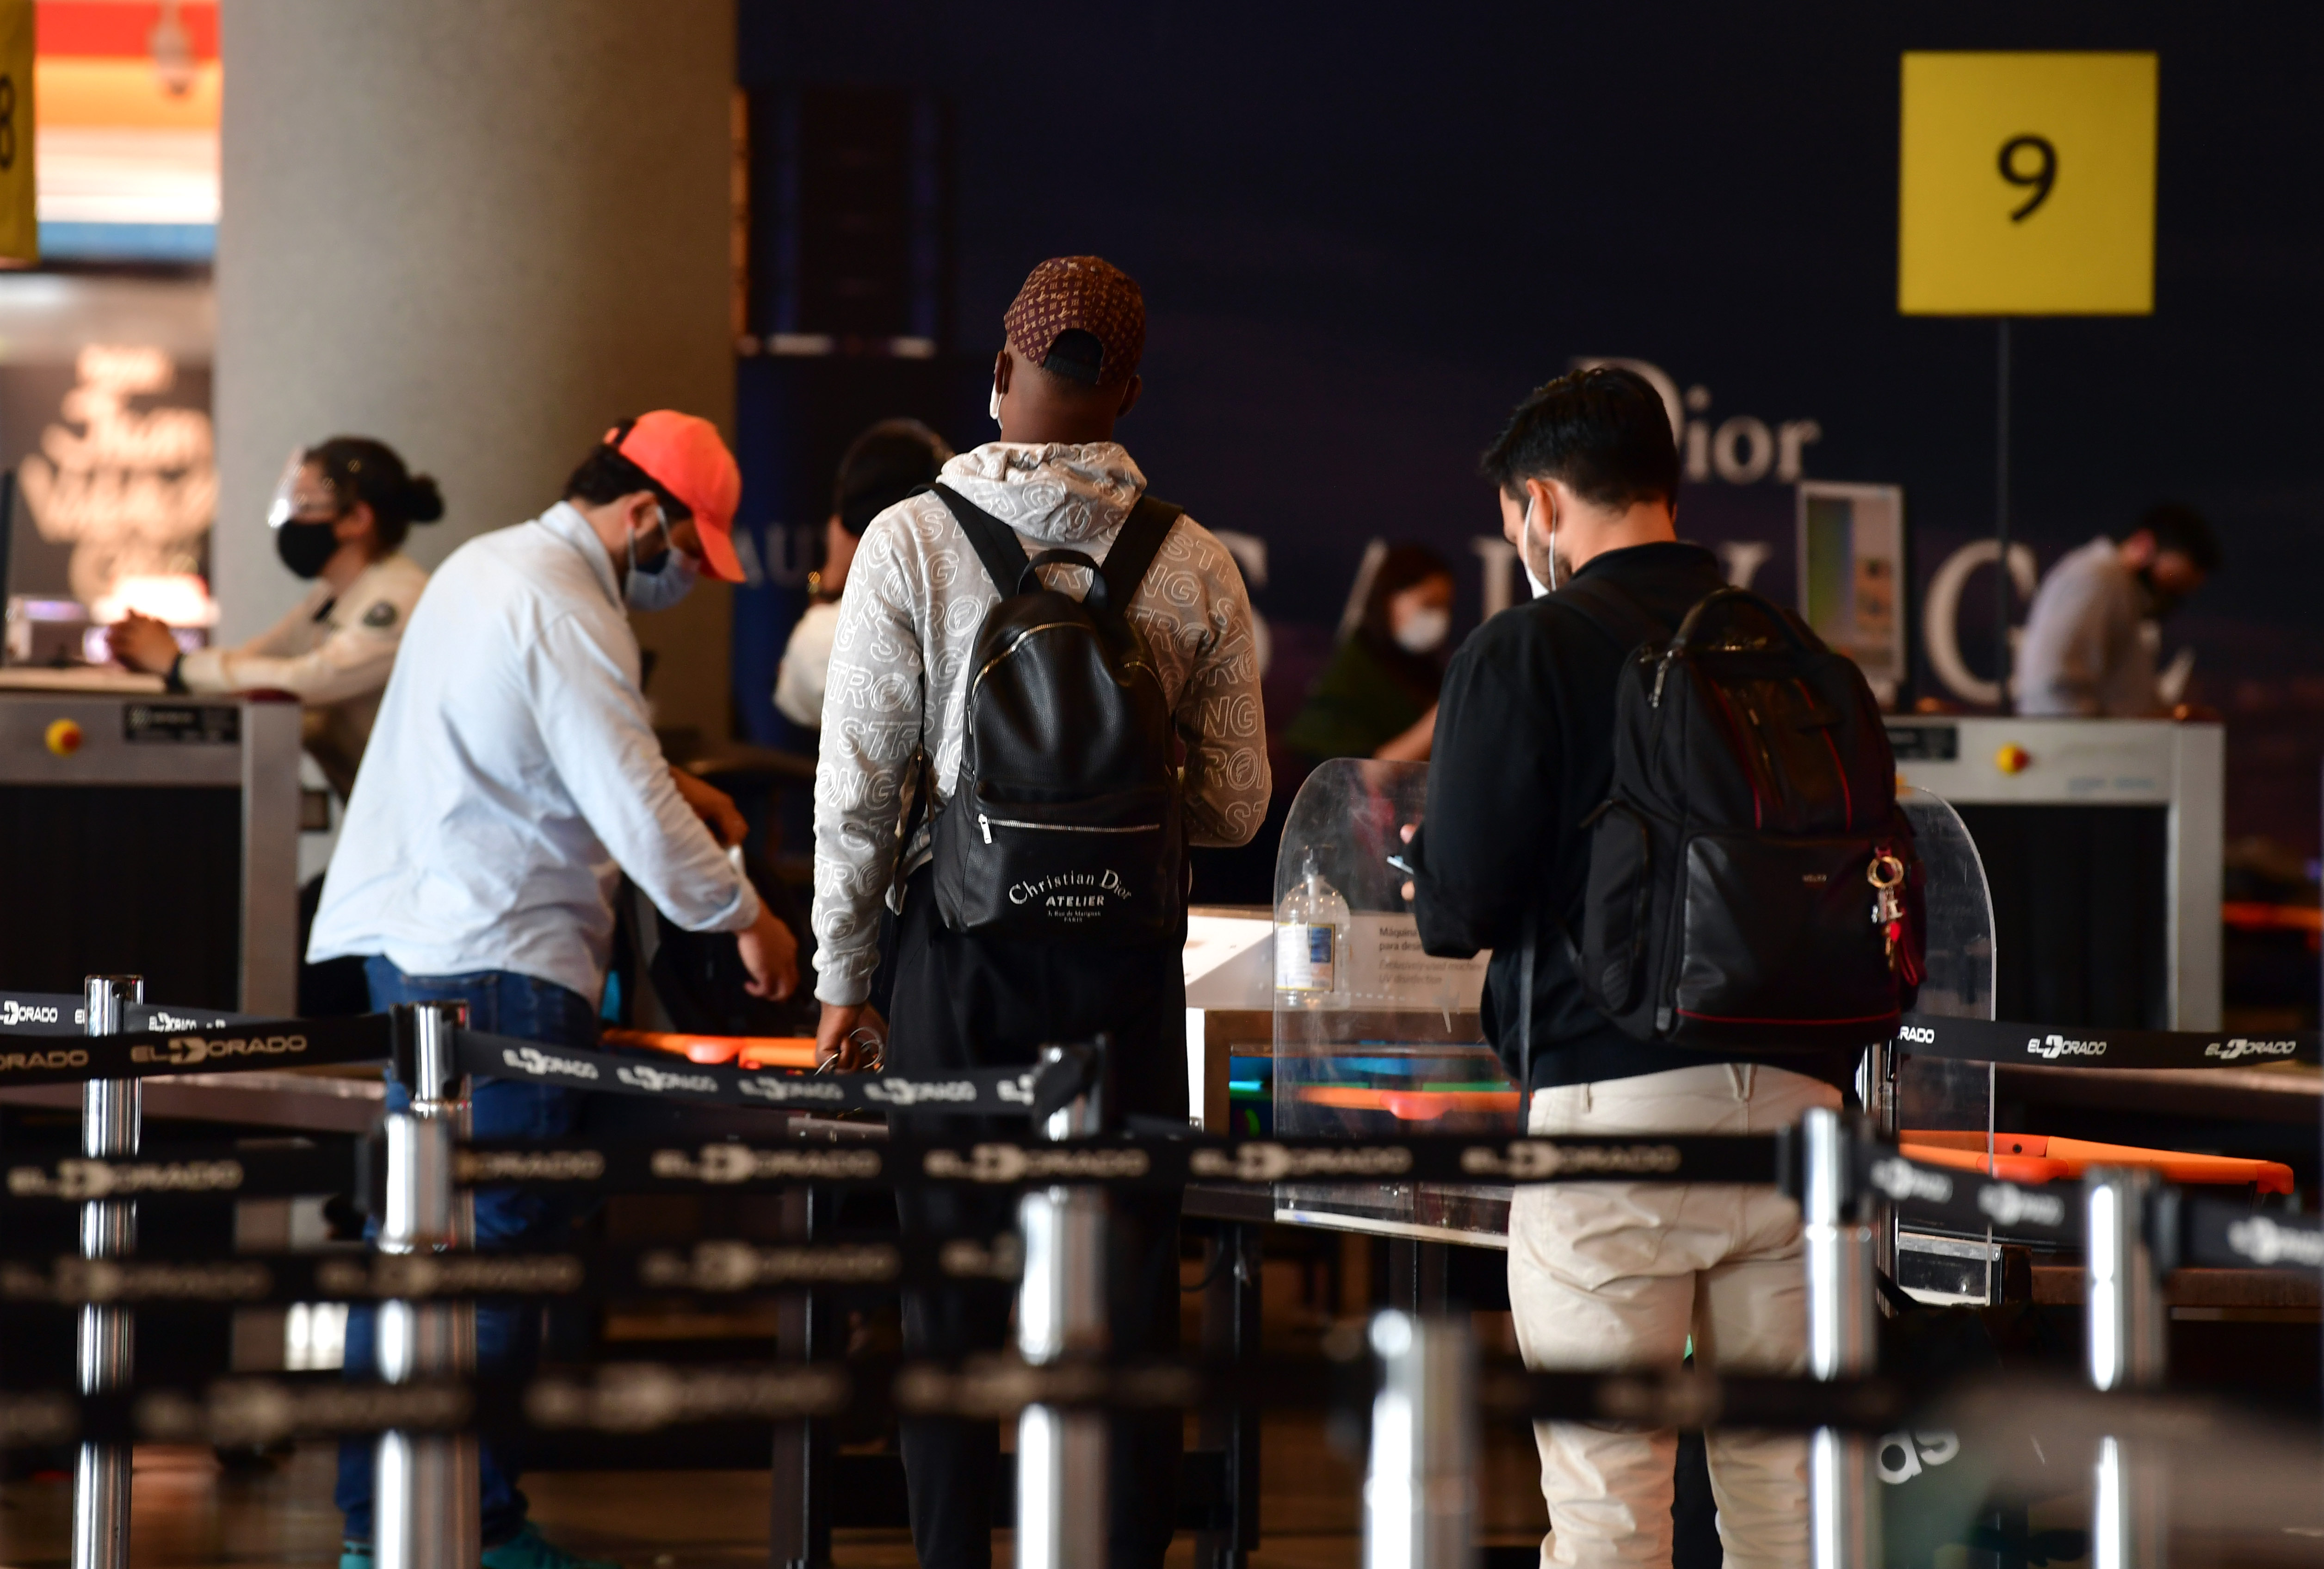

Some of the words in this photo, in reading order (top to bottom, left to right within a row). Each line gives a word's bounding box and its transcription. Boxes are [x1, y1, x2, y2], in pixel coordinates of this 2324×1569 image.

[1997, 132, 2058, 226] 9
[837, 717, 922, 761] STR
[1009, 870, 1094, 905] Christian
[1099, 869, 1131, 900] Dior
[1045, 895, 1105, 907] ATELIER
[0, 1000, 58, 1025] DORADO
[1898, 1025, 1935, 1044] RADO
